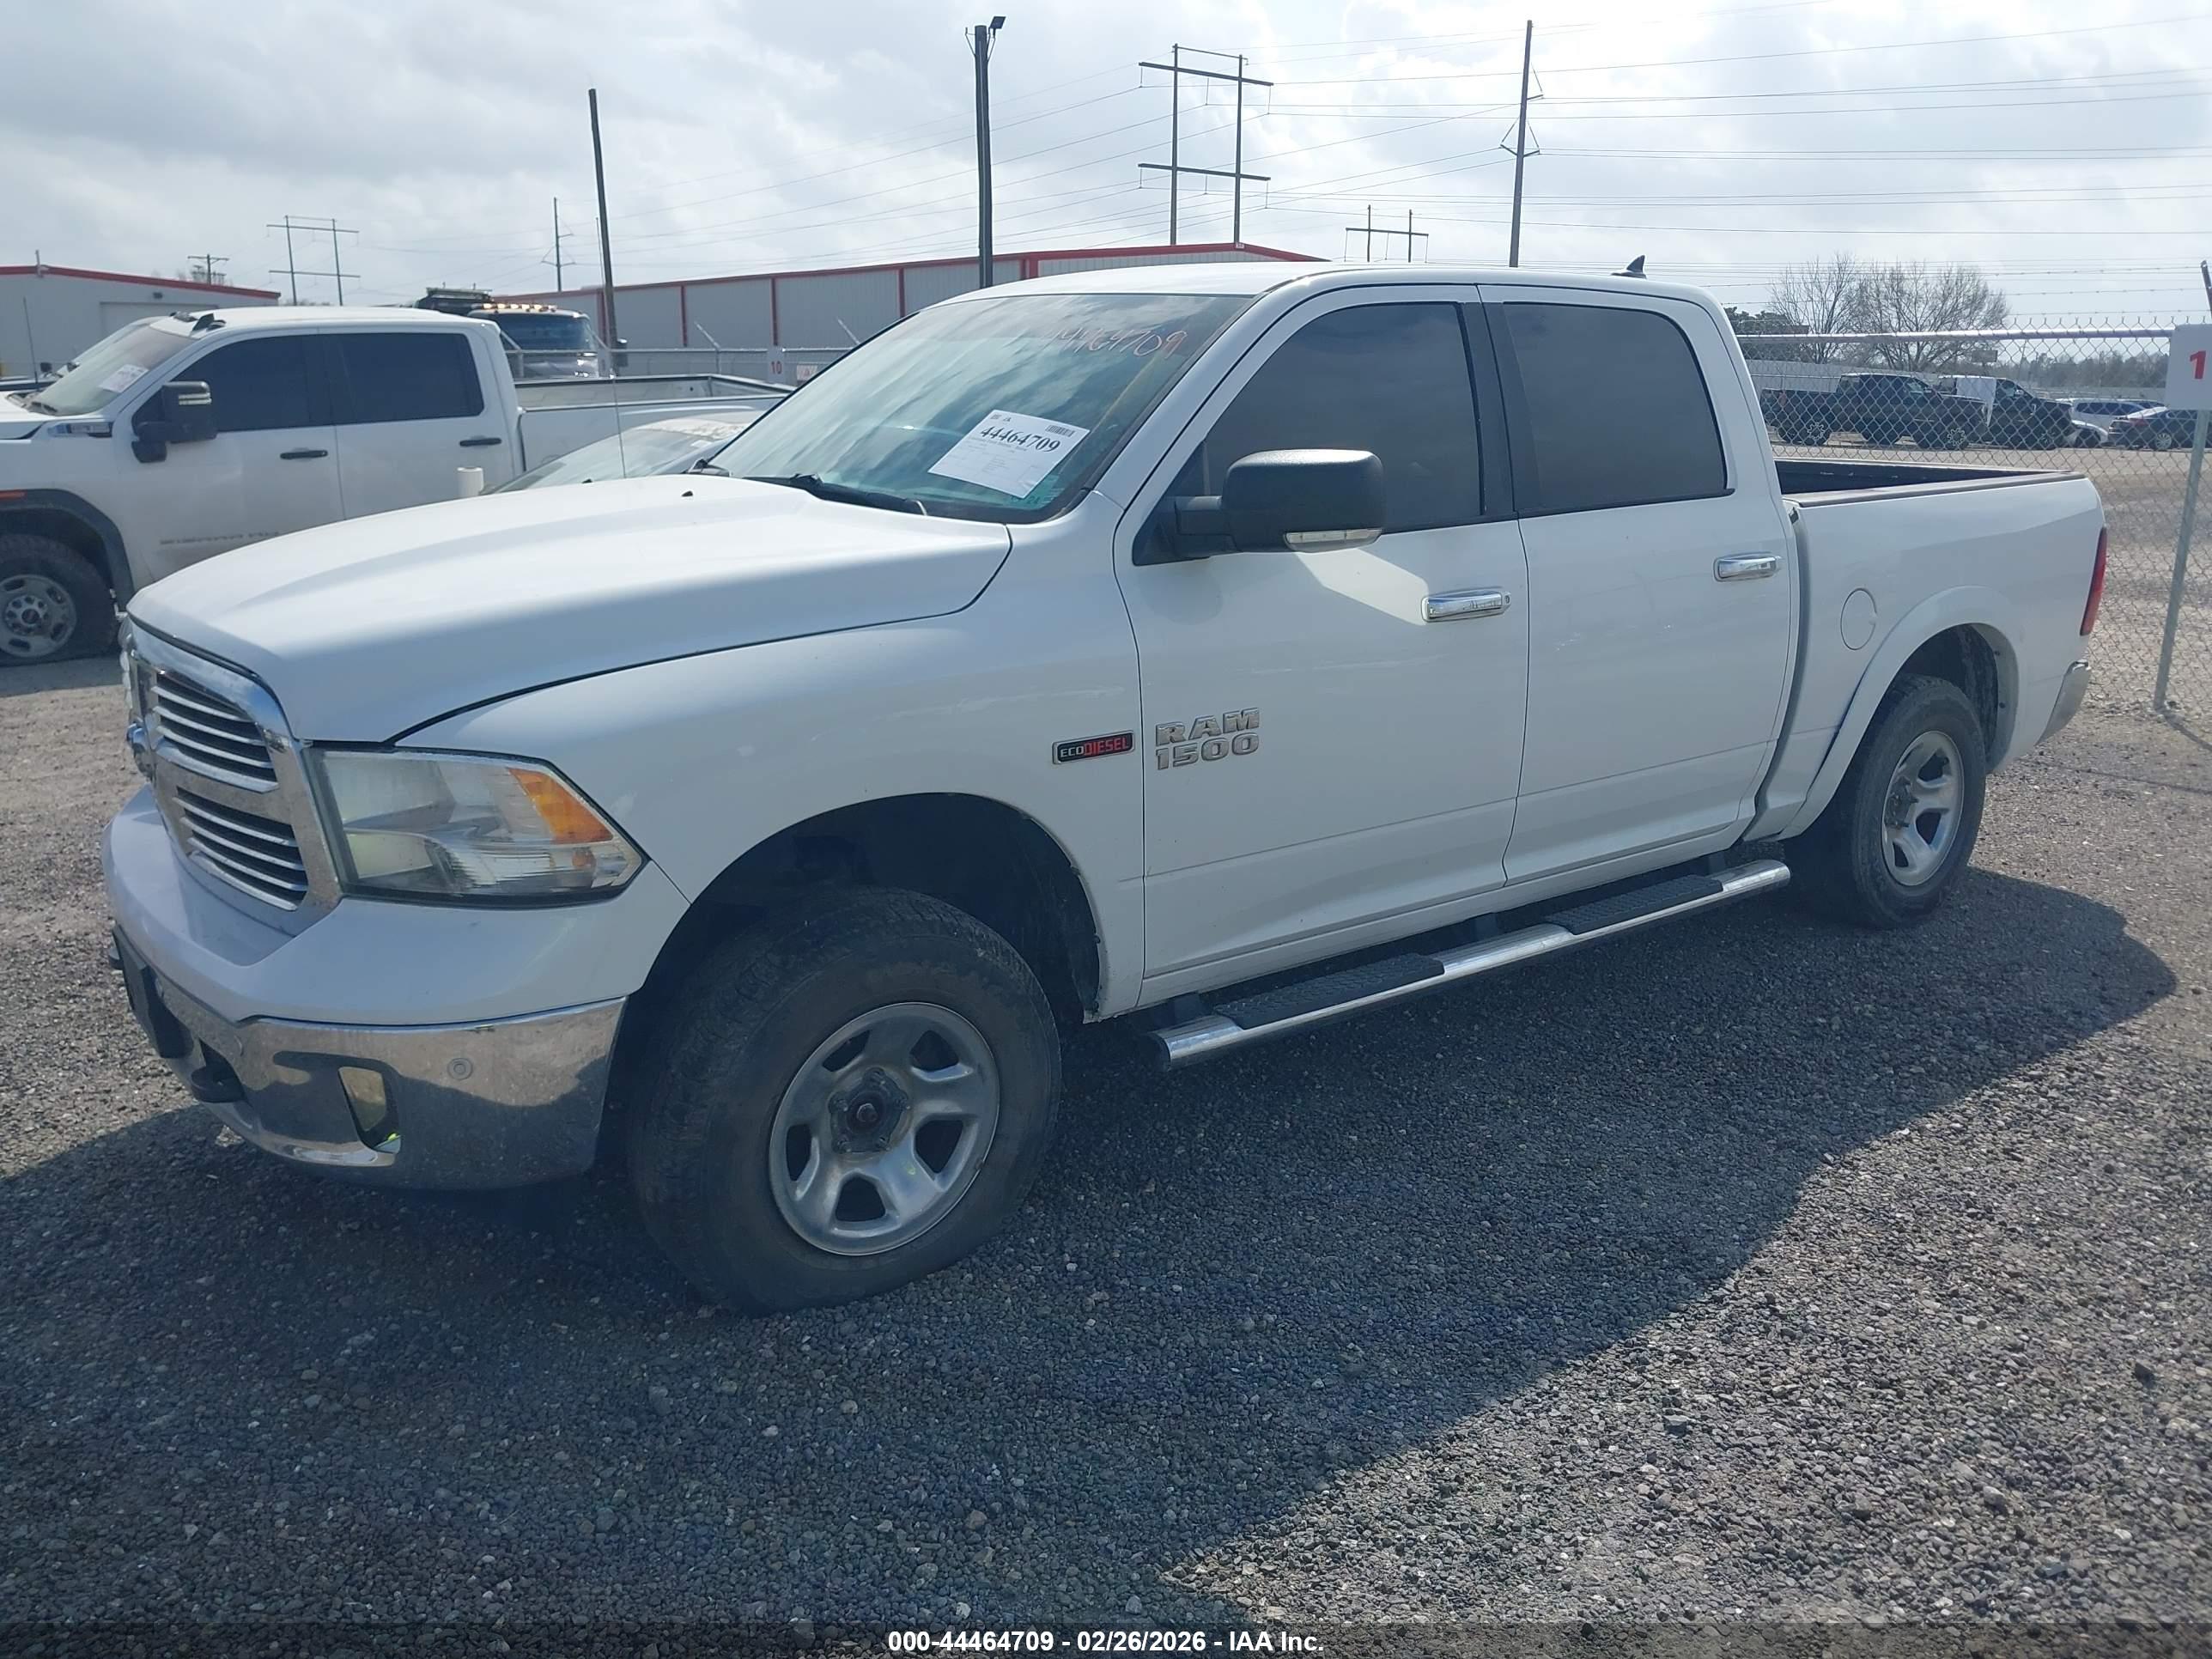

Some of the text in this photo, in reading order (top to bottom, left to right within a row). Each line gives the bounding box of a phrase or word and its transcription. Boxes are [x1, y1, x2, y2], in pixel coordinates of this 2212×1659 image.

[770, 361, 782, 374] 10
[980, 426, 1061, 453] 44464709
[1155, 707, 1260, 746] RAM
[1155, 732, 1259, 770] 1500
